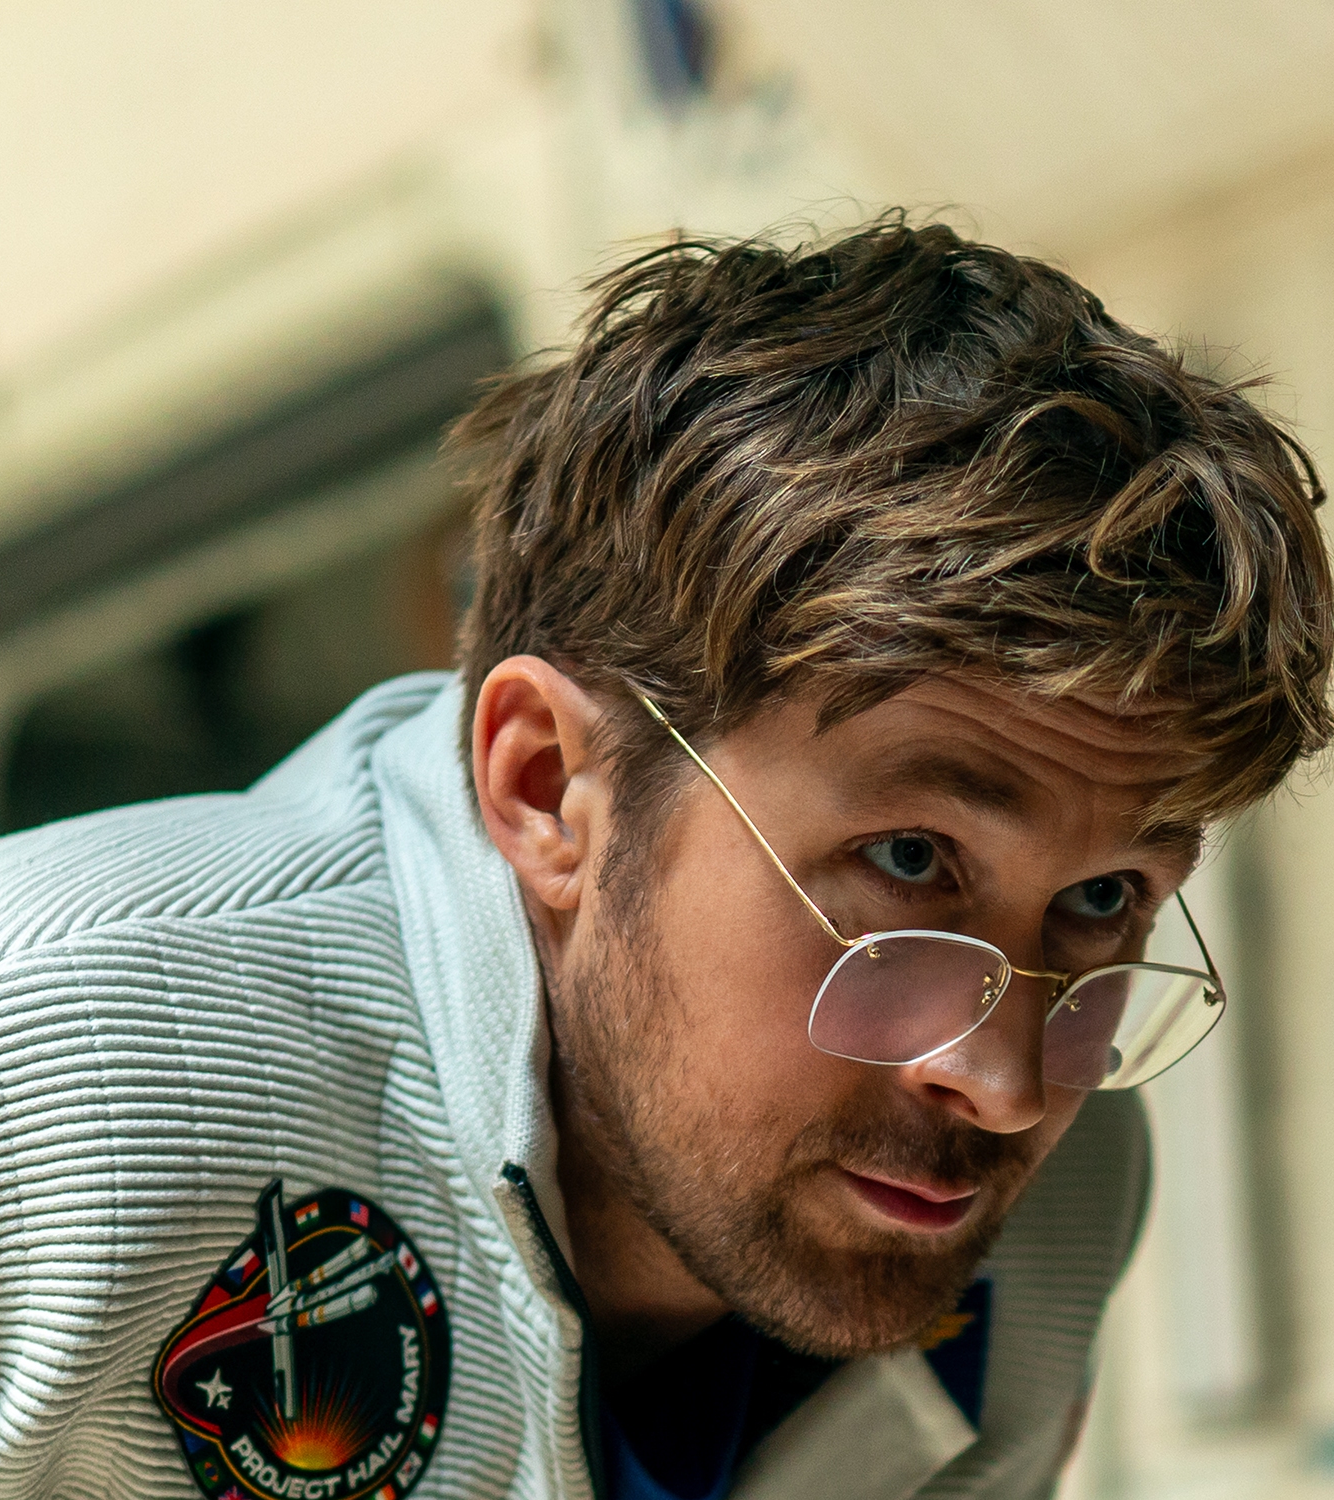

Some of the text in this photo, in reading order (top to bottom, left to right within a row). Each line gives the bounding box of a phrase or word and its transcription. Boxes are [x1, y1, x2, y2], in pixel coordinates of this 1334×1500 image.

[232, 1326, 419, 1498] PROJECT HAIL MARY
